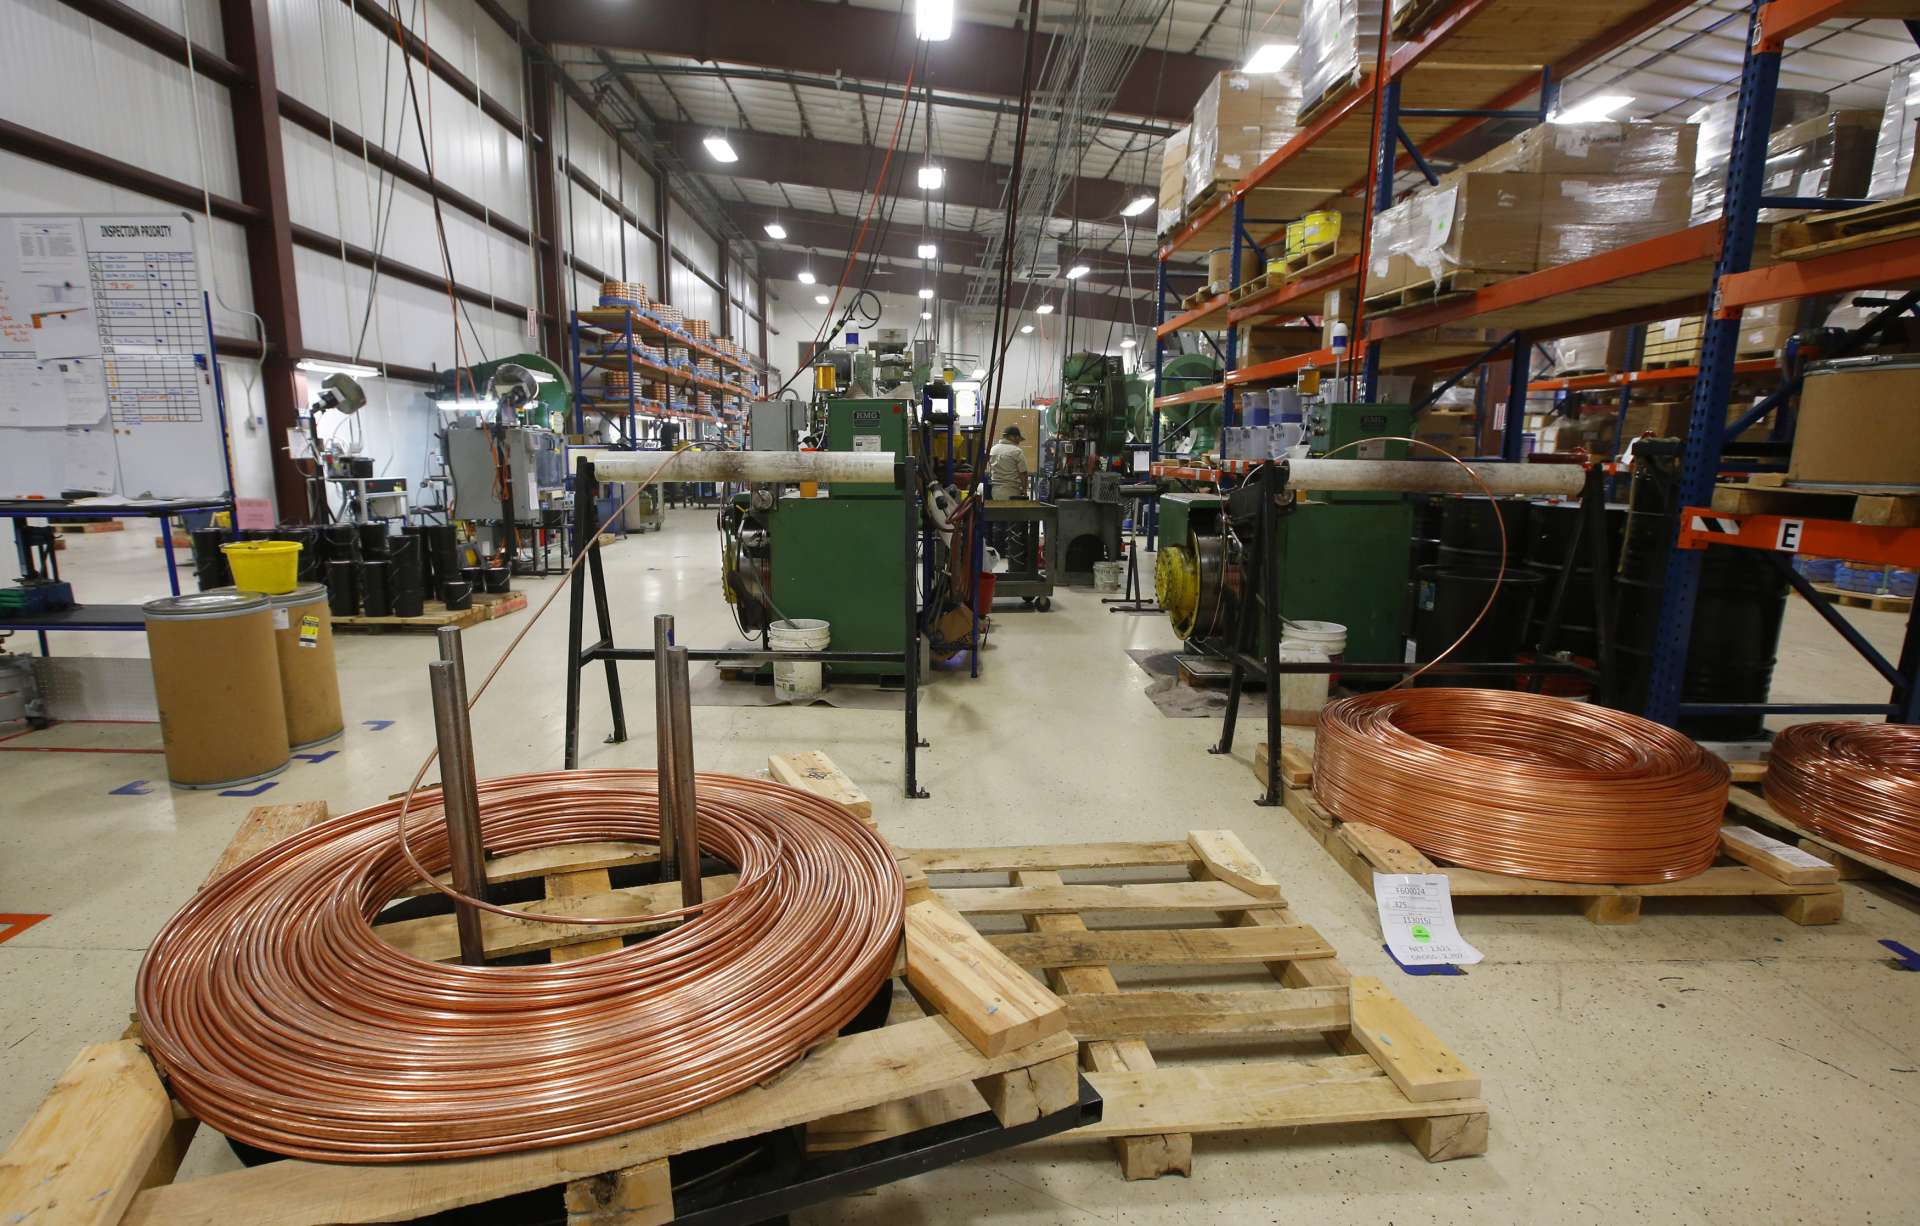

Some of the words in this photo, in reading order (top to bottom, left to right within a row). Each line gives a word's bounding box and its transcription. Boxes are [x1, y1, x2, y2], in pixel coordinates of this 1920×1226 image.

[100, 225, 140, 238] INSPECTION
[140, 225, 172, 238] PRIORITY
[1781, 523, 1799, 548] E
